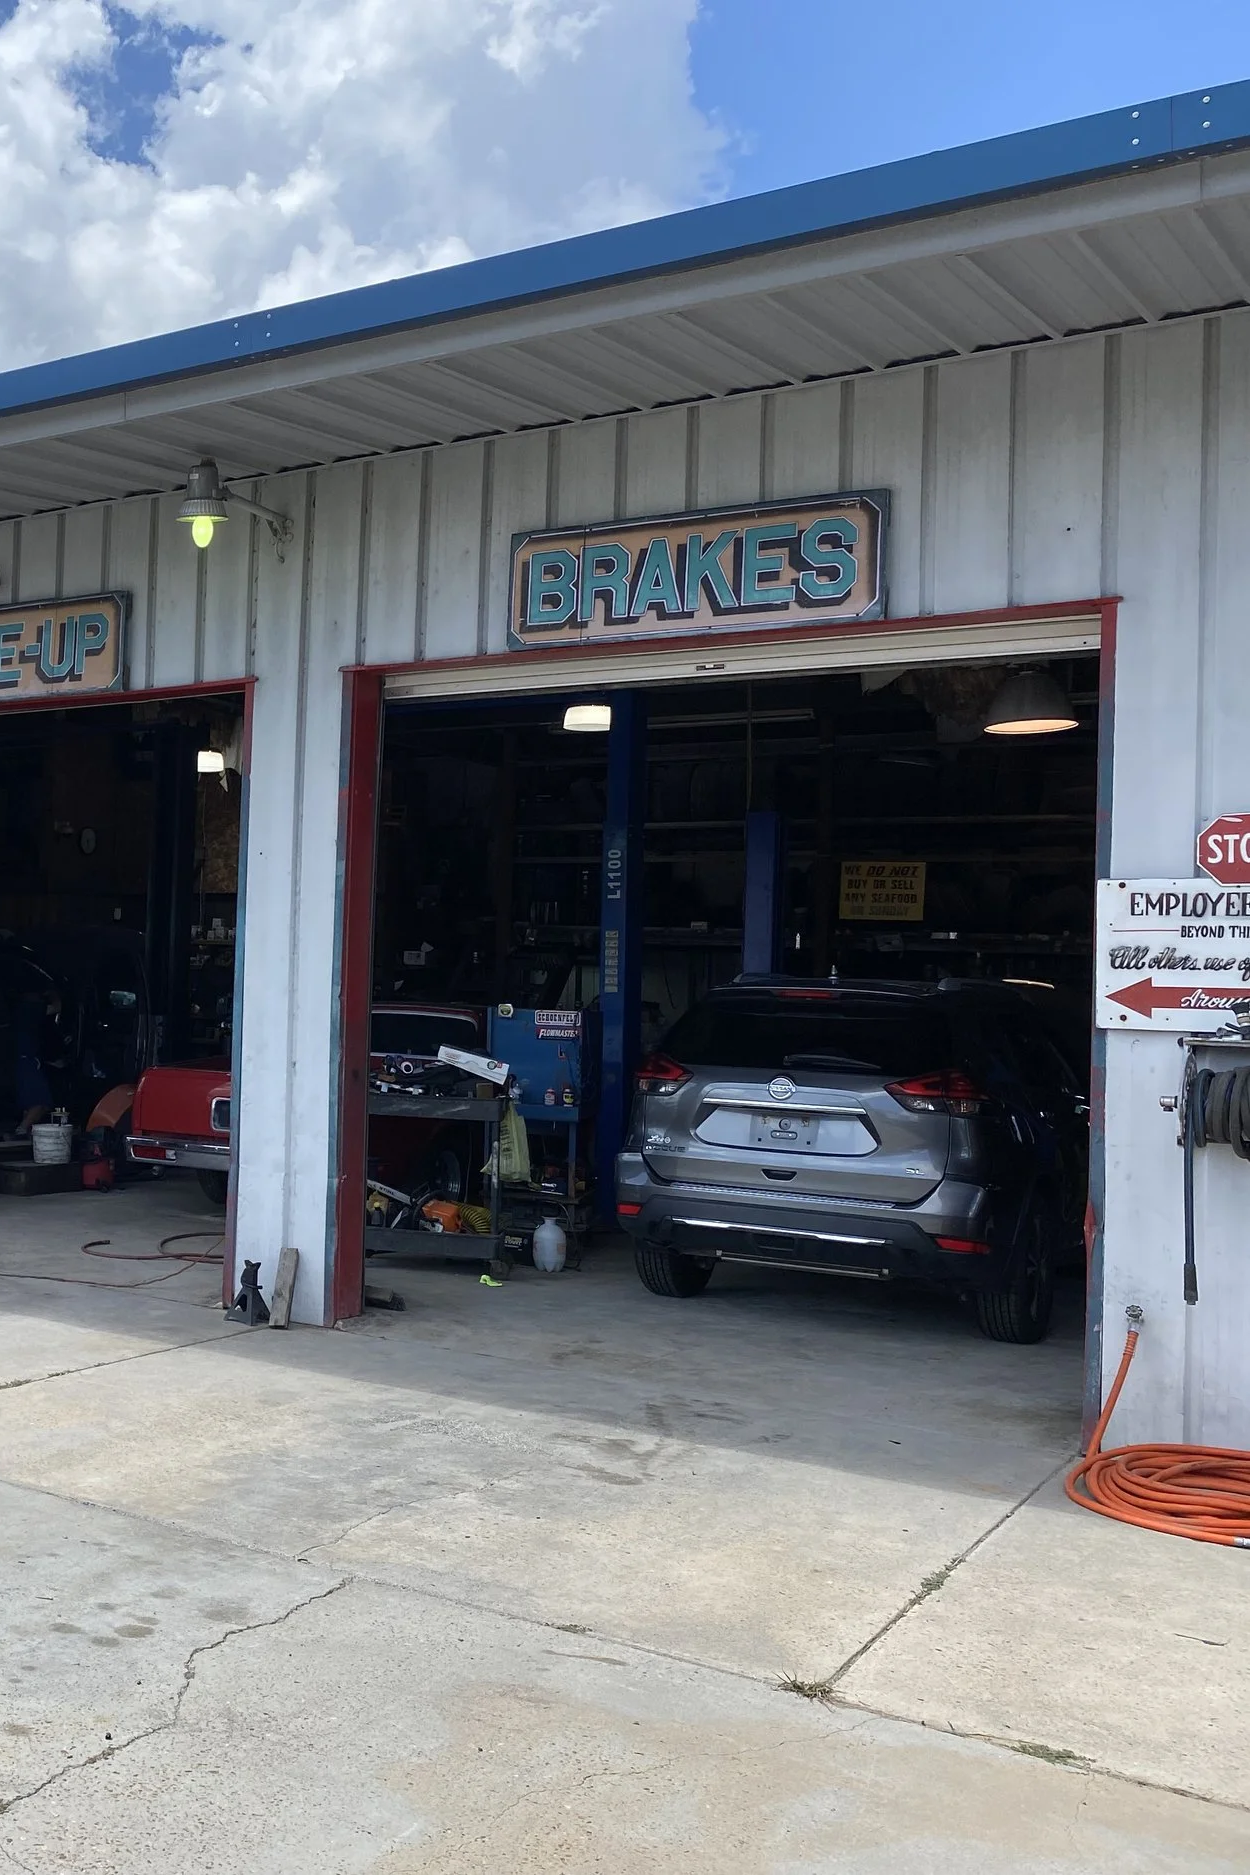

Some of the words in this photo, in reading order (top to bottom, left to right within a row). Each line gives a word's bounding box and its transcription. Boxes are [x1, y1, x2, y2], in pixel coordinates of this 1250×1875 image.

[526, 514, 860, 627] BRAKES
[607, 849, 622, 899] L1100
[844, 865, 862, 876] WE
[867, 866, 886, 876] DO
[890, 866, 919, 877] NOT
[847, 879, 868, 890] BUY
[873, 880, 886, 889] OR
[891, 879, 915, 890] SELL
[844, 893, 866, 903] ANY
[871, 893, 918, 904] SEAFOOD
[1181, 925, 1225, 938] BEYOND
[1109, 945, 1149, 970] All
[1148, 947, 1201, 971] others
[1203, 957, 1236, 971] use
[1181, 988, 1250, 1008] Arou
[905, 1167, 925, 1175] SL
